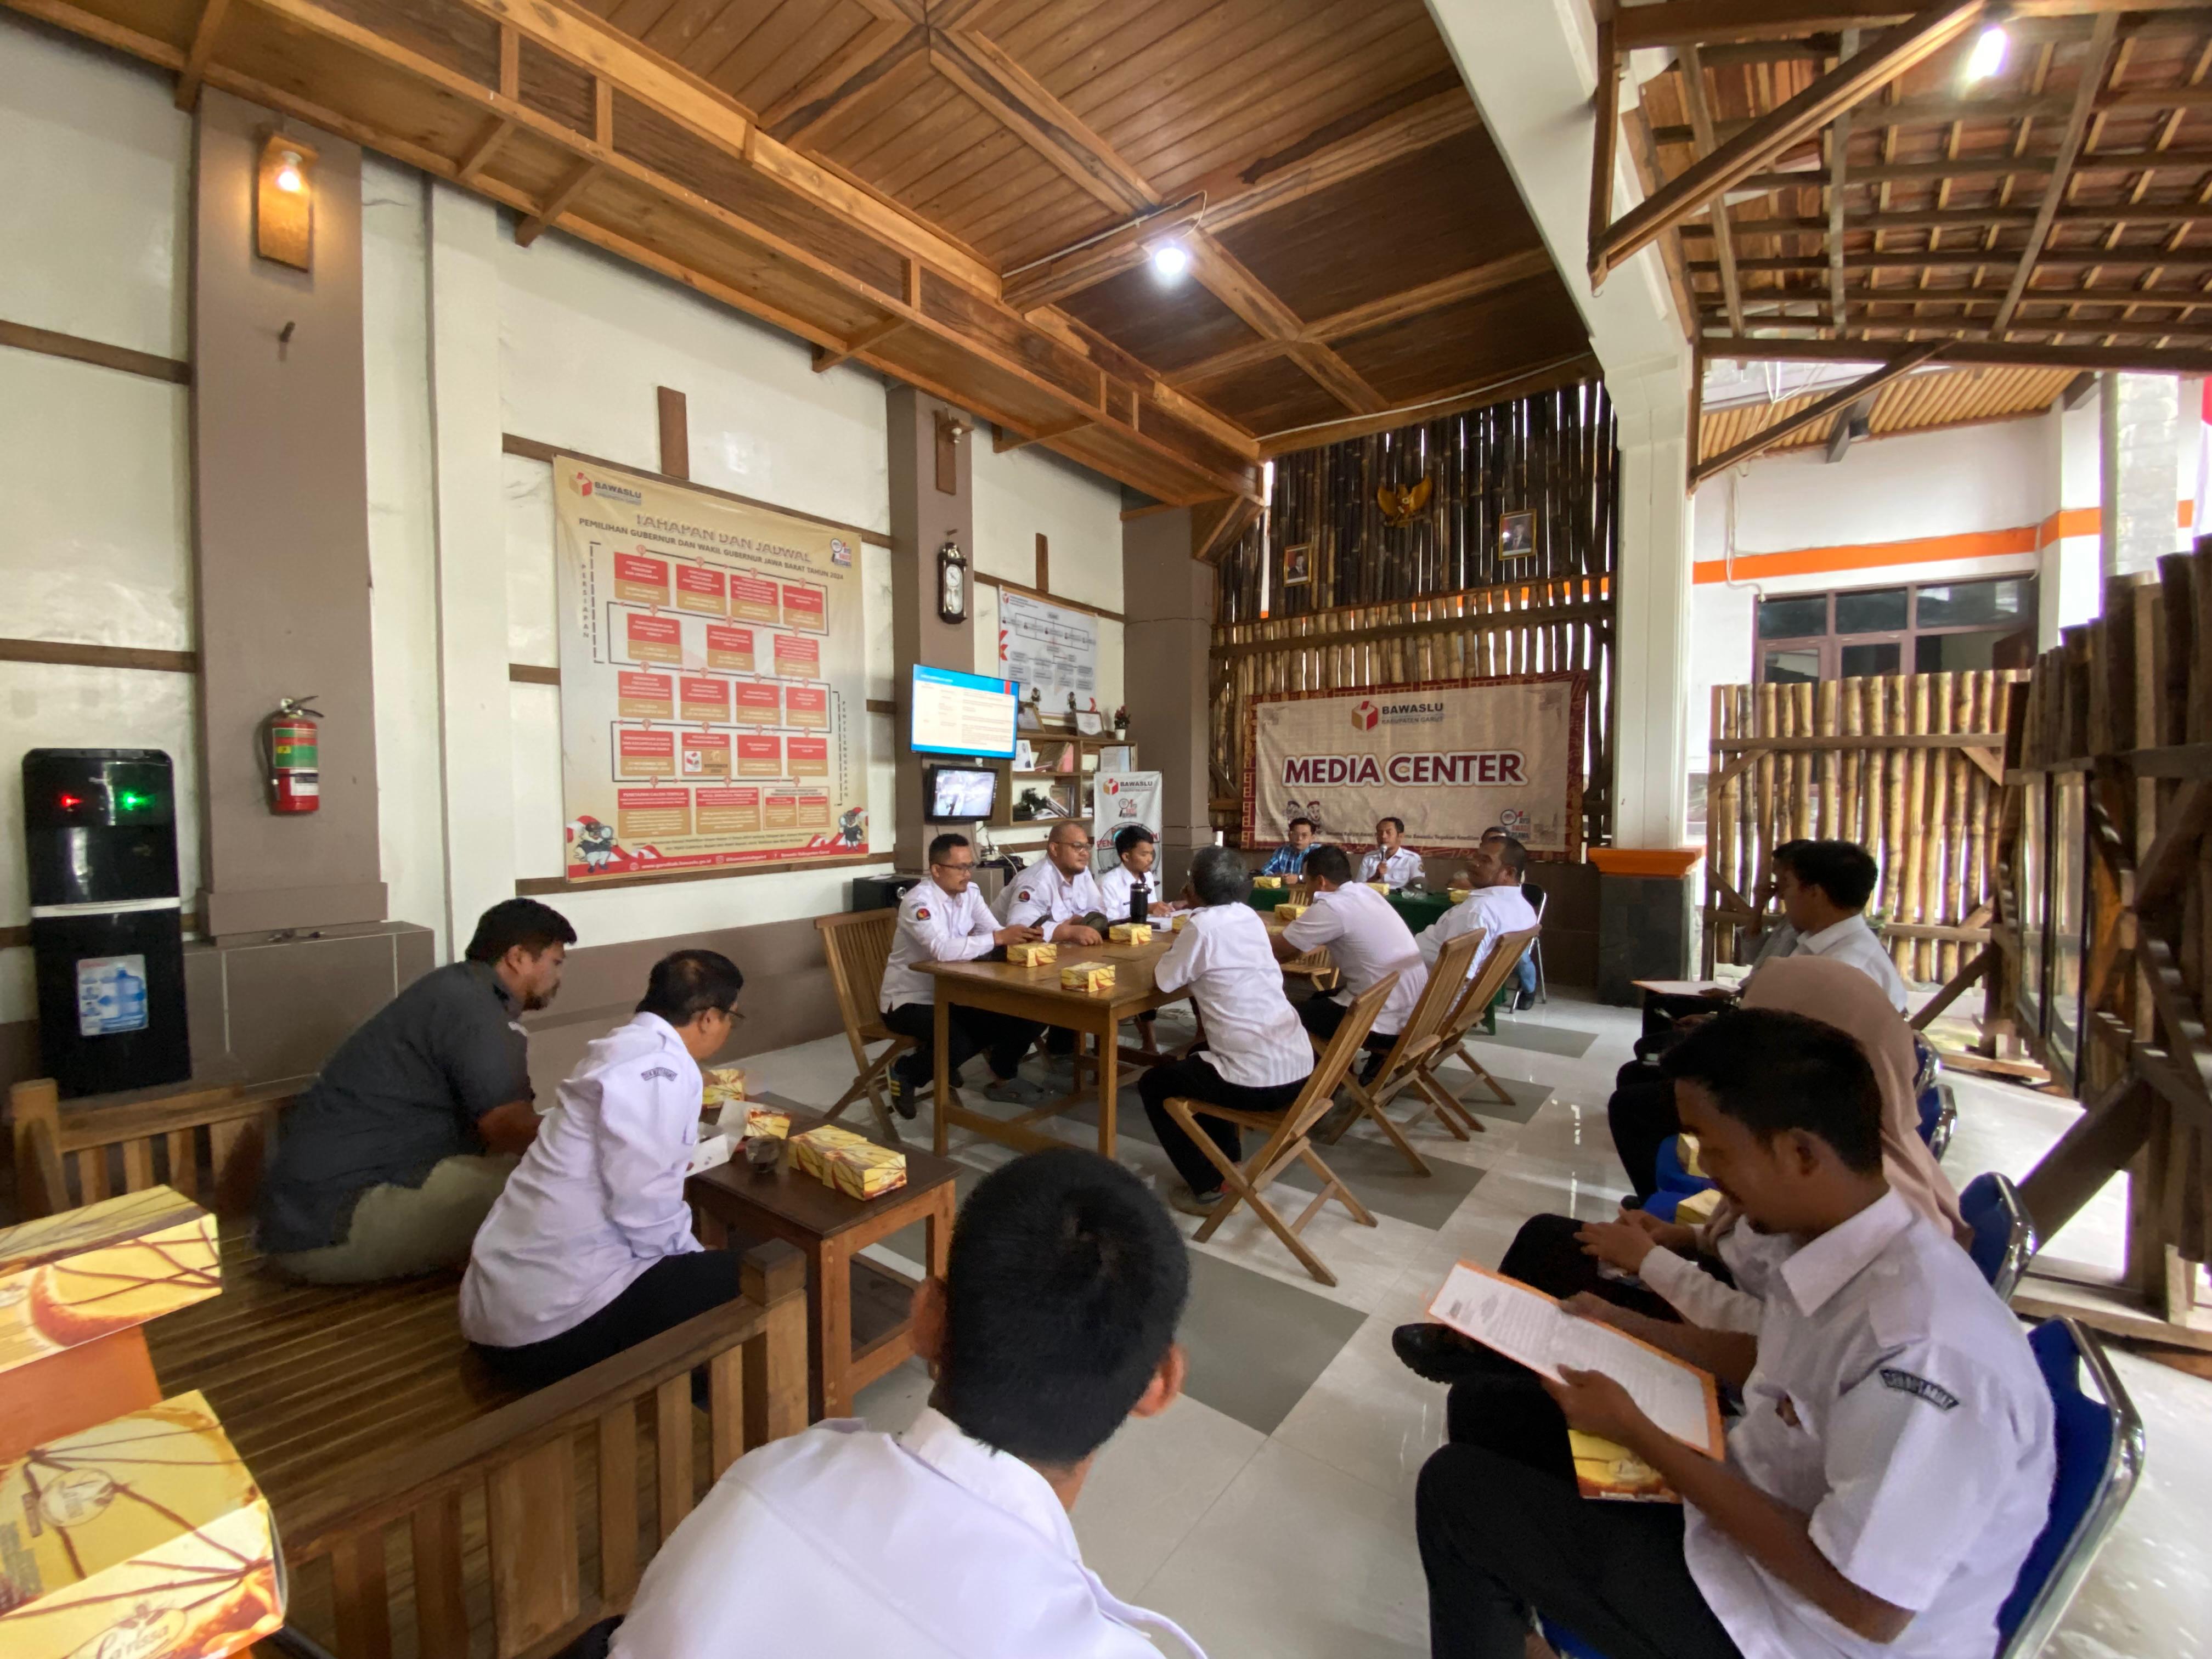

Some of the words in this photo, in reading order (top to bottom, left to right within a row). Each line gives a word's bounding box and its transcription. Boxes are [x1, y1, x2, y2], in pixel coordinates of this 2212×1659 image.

[595, 482, 642, 498] BAWASLU
[579, 518, 628, 534] PEMILIHAN
[630, 529, 676, 544] GUBERNUR
[678, 539, 696, 549] DAN
[698, 544, 721, 555] WAKIL
[724, 549, 762, 563] GUBERNUR
[764, 557, 783, 567] JAWA
[785, 562, 805, 572] BARAT
[807, 567, 829, 577] TAHUN
[637, 514, 715, 541] TAHAPAN
[719, 533, 752, 549] DAN
[756, 540, 811, 563] JADWAL
[1382, 703, 1443, 714] BAWASLU
[1284, 758, 1381, 783] MEDIA
[1389, 754, 1523, 782] CENTER
